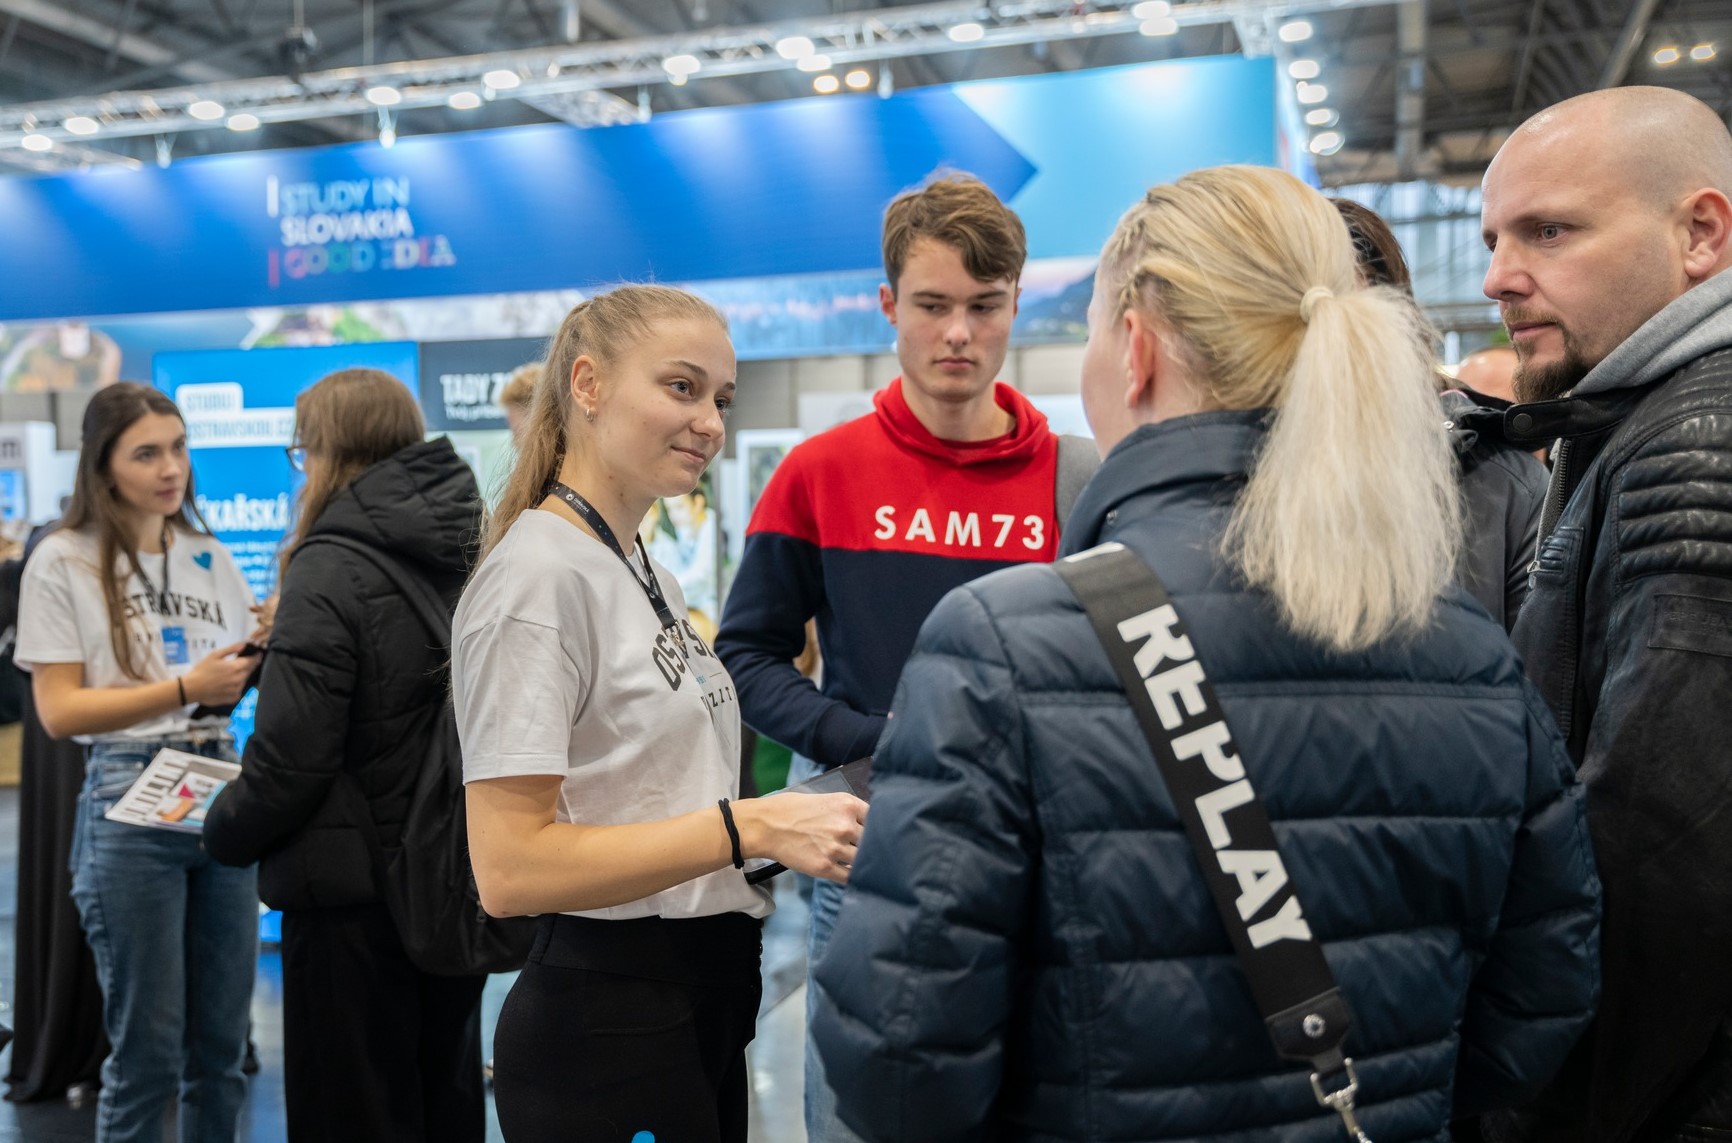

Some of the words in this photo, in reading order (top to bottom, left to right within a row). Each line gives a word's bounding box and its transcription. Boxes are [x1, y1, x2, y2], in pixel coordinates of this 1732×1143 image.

[281, 177, 370, 215] STUDY
[372, 174, 411, 208] IN
[280, 207, 414, 246] SLOVAKIA
[285, 240, 374, 279] GOOD
[440, 372, 489, 404] TADY
[874, 505, 1045, 550] SAM73
[1117, 603, 1313, 949] REPLAY
